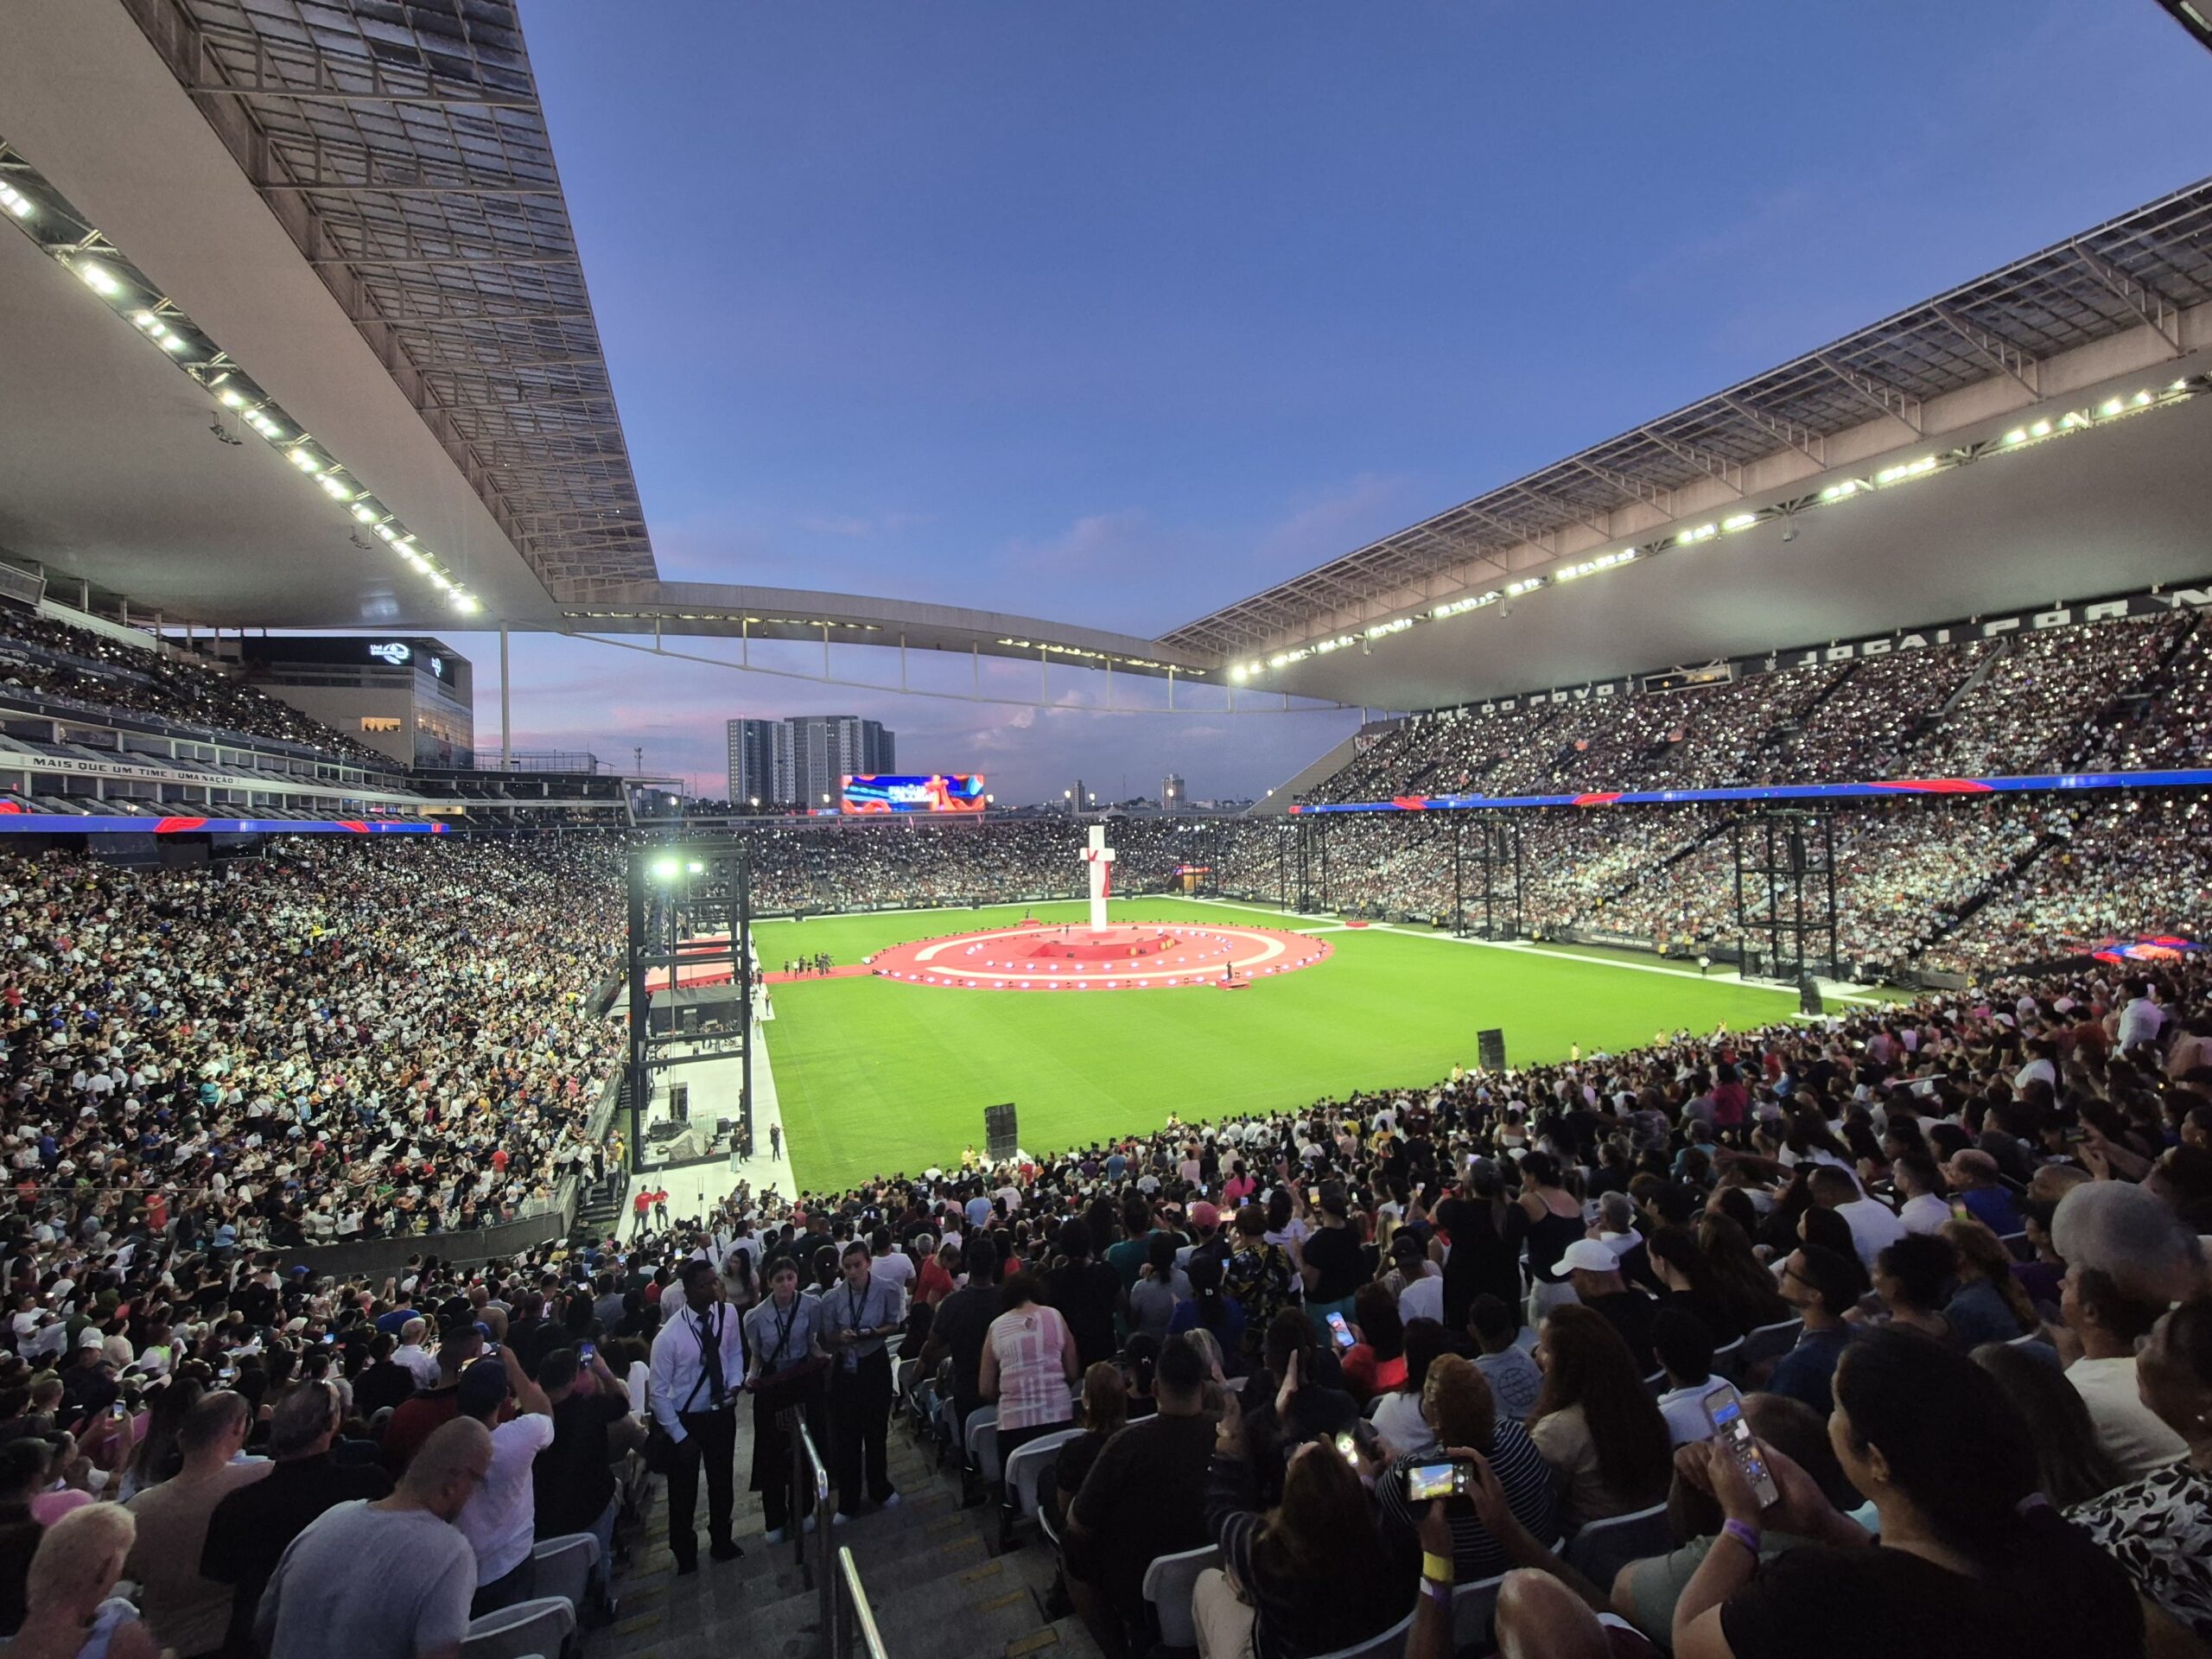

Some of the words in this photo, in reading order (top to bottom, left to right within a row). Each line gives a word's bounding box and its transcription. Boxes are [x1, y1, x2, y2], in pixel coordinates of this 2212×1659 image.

[1797, 629, 1949, 666] JOGAI
[1982, 600, 2128, 637] POR
[1411, 708, 1469, 723] TIME
[1481, 700, 1516, 715] DO
[1530, 684, 1614, 707] POVO
[33, 758, 73, 768] MAIS
[78, 762, 107, 771] QUE
[139, 768, 168, 778] TIME
[178, 772, 200, 781] UMA
